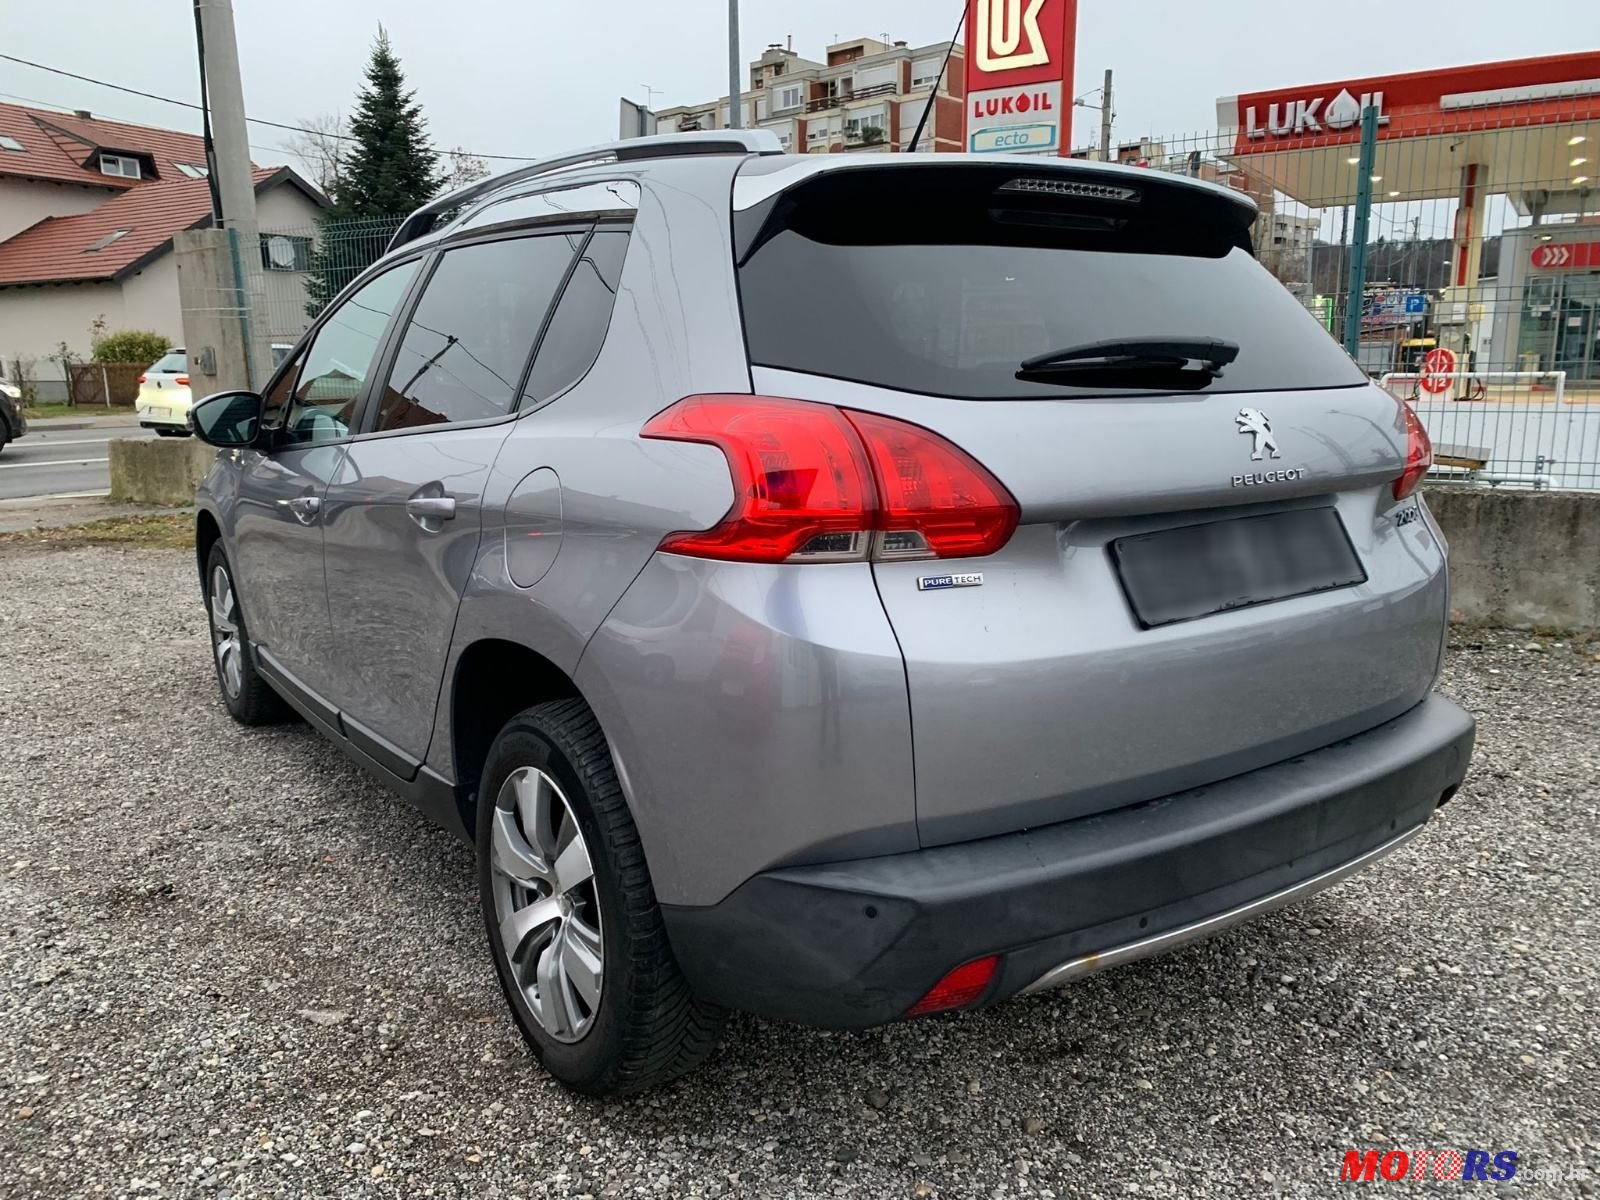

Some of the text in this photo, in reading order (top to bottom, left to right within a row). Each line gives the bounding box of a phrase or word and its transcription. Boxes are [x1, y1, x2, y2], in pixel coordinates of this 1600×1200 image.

[974, 92, 1052, 118] LUKOIL
[1246, 88, 1390, 139] LUKOIL
[994, 132, 1029, 147] ecto
[1410, 298, 1420, 313] P
[1231, 468, 1305, 488] PEUGEOT
